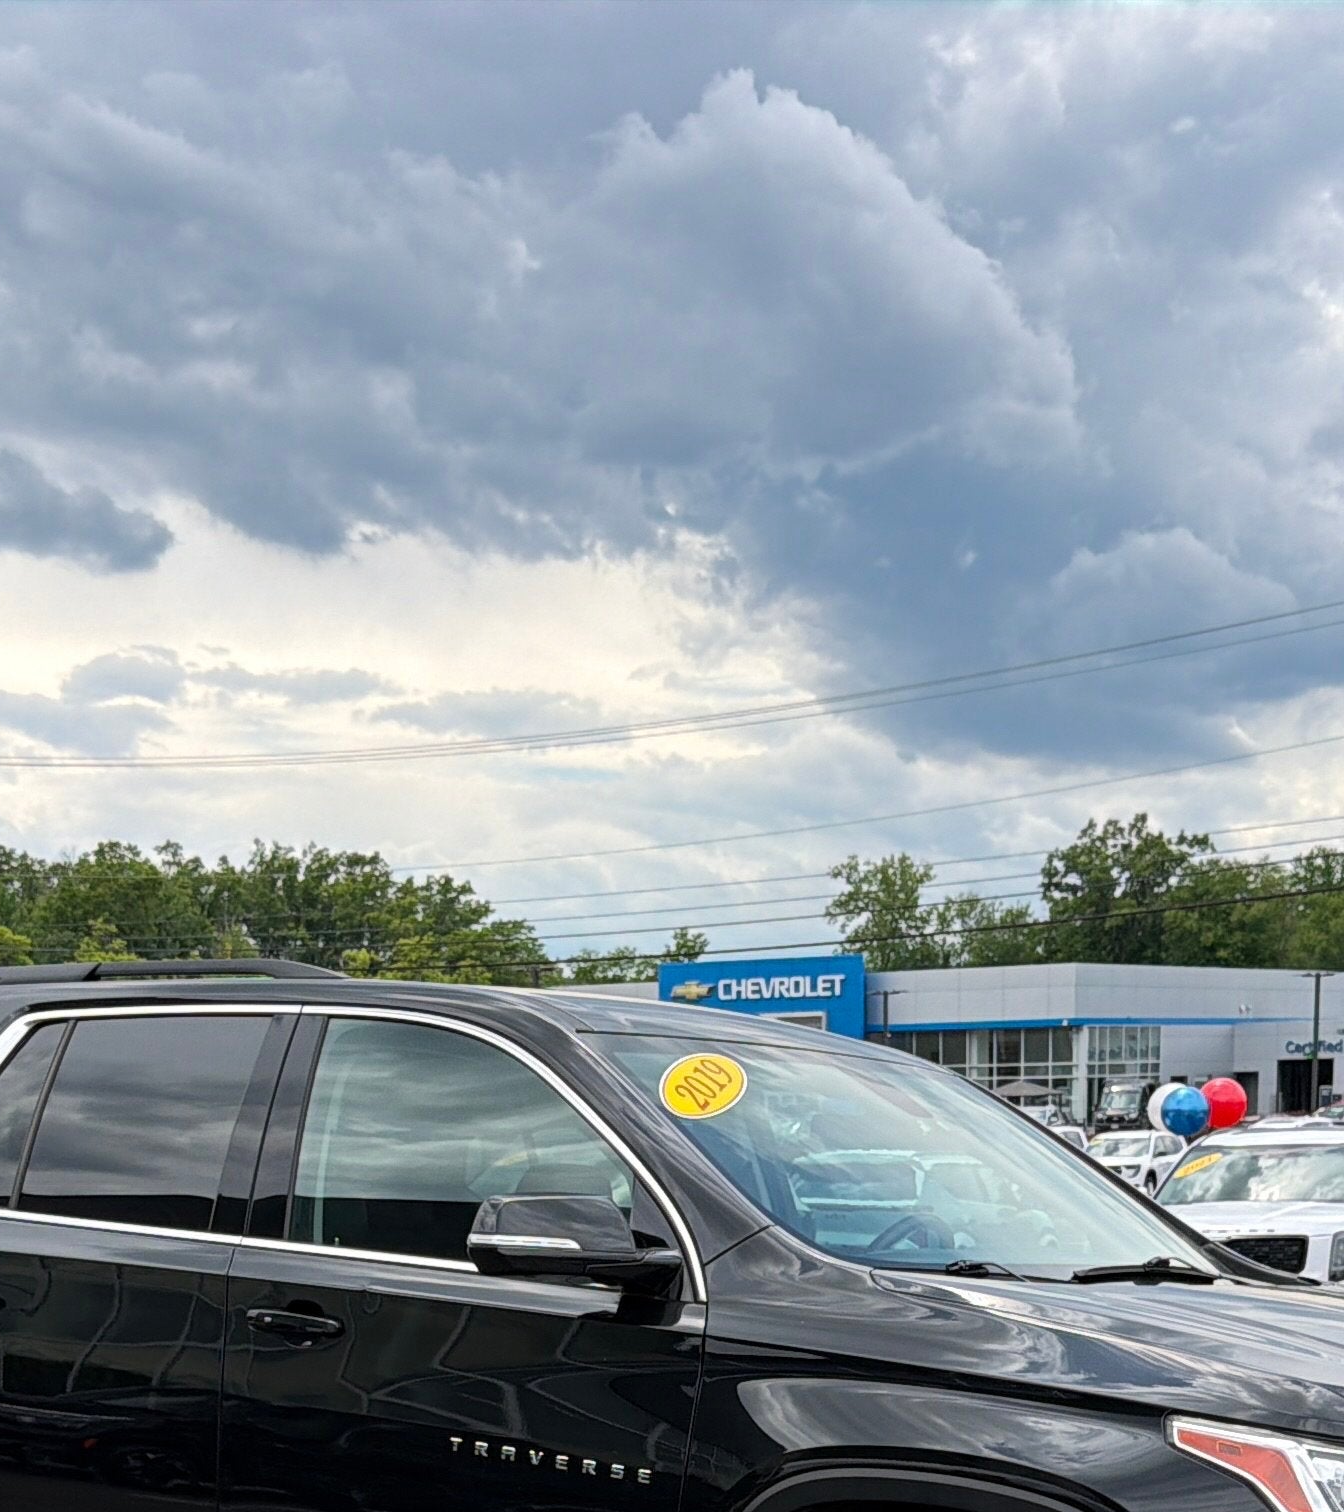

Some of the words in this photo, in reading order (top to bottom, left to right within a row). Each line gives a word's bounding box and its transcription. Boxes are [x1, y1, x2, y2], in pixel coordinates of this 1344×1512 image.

[717, 974, 846, 1001] CHEVROLET
[674, 1059, 733, 1111] 2019
[449, 1436, 653, 1485] TRAVERSE
